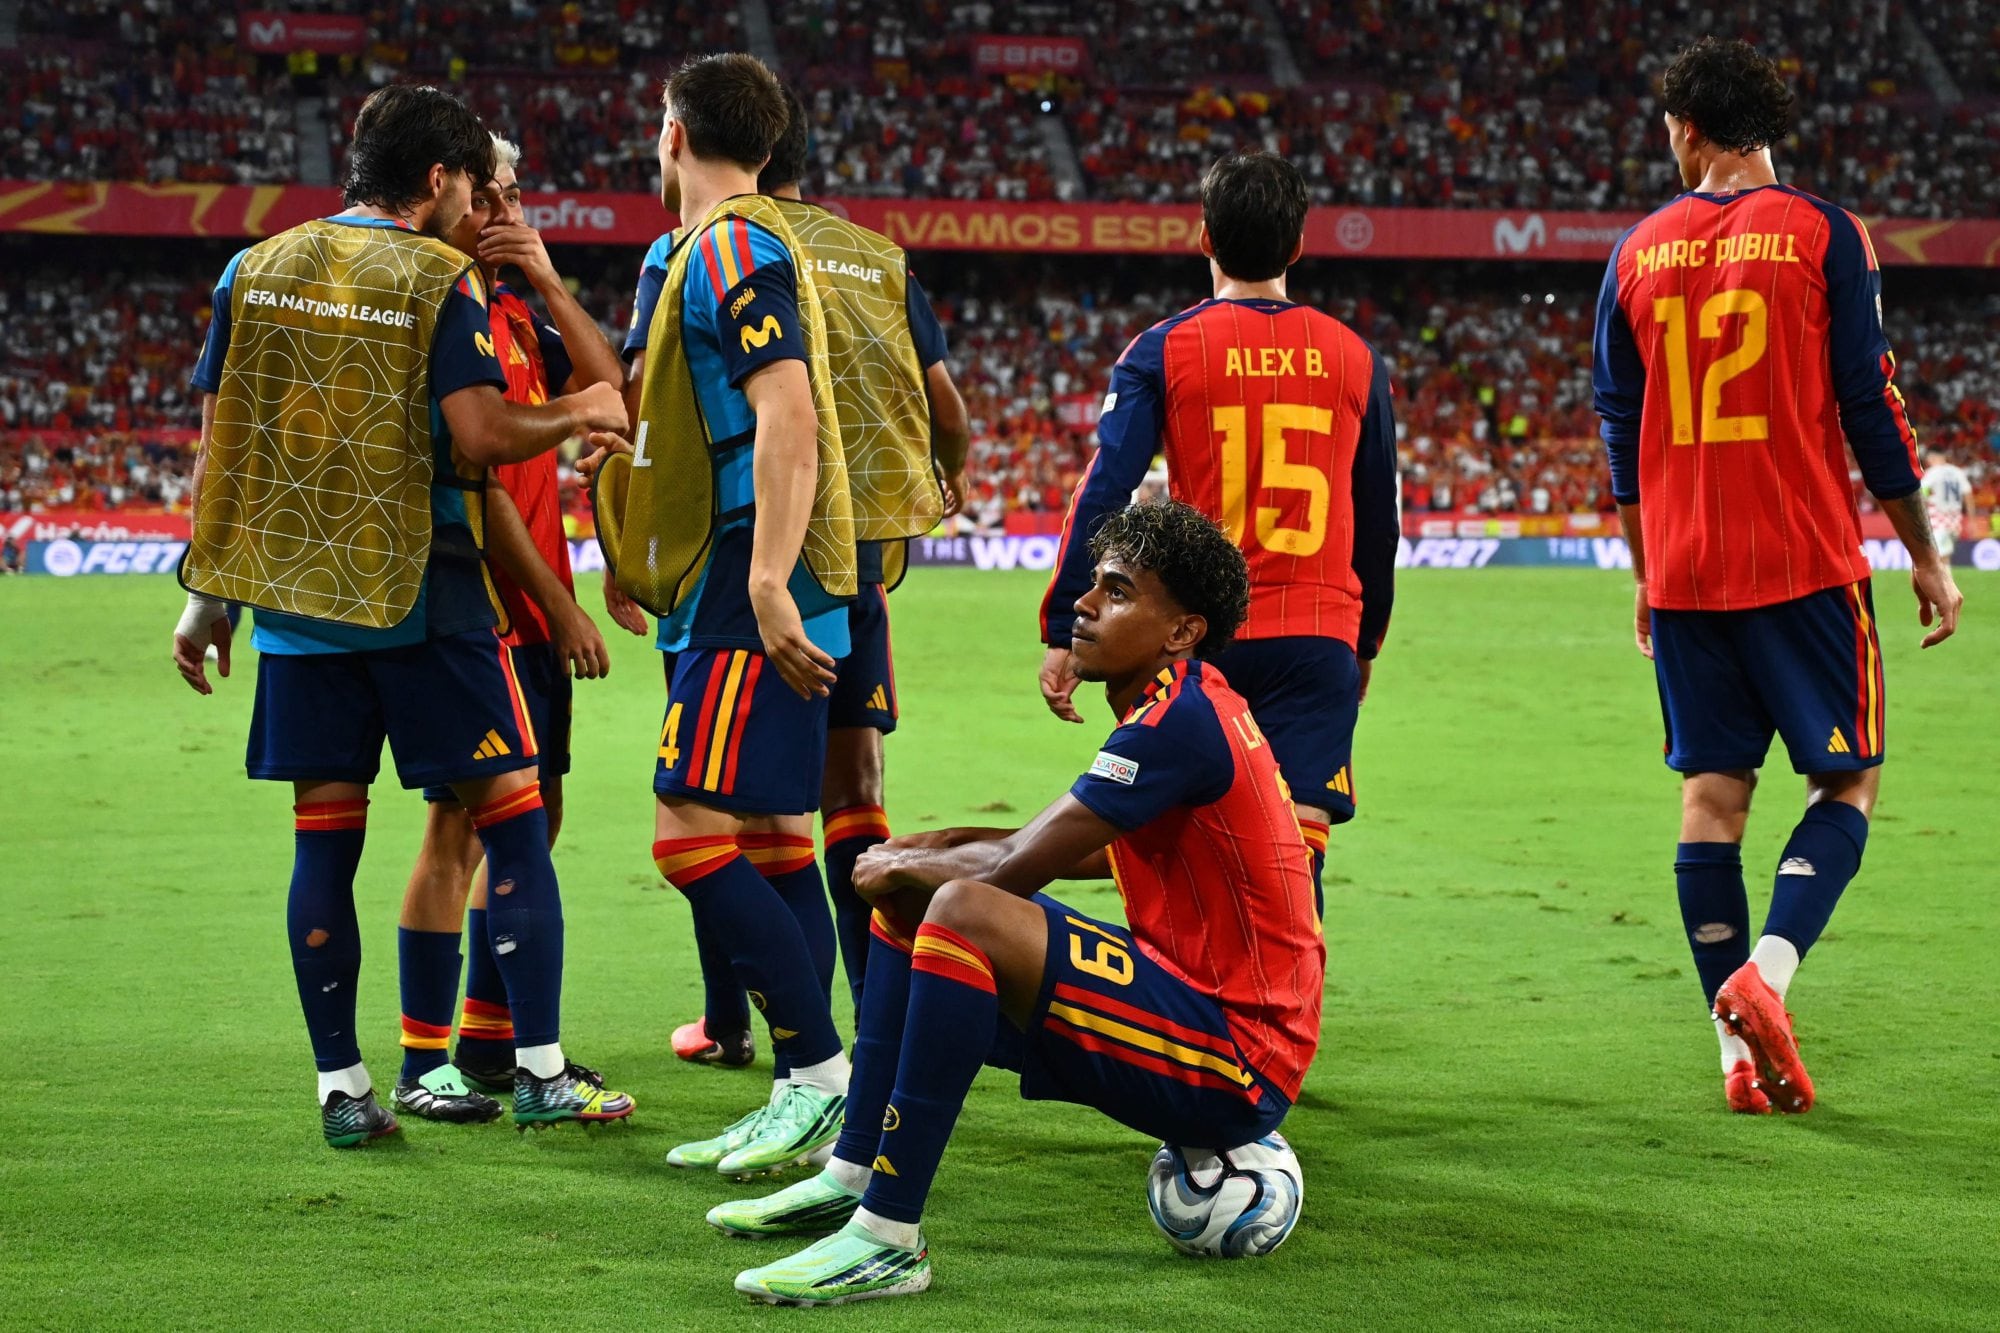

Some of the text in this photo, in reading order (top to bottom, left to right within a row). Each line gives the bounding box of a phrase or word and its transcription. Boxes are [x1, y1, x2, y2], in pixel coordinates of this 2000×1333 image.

[522, 199, 616, 230] pfre
[1091, 215, 1203, 248] ESP
[816, 259, 882, 284] LEAGUE
[1636, 233, 1800, 277] MARC PUBILL
[280, 293, 348, 319] NATIONS
[349, 305, 415, 330] LEAGUE
[730, 287, 757, 320] ESPAÑA
[1225, 347, 1329, 379] ALEX B.
[1654, 289, 1769, 446] 12
[1212, 403, 1333, 557] 15
[921, 539, 967, 561] THE
[1548, 539, 1589, 560] THE
